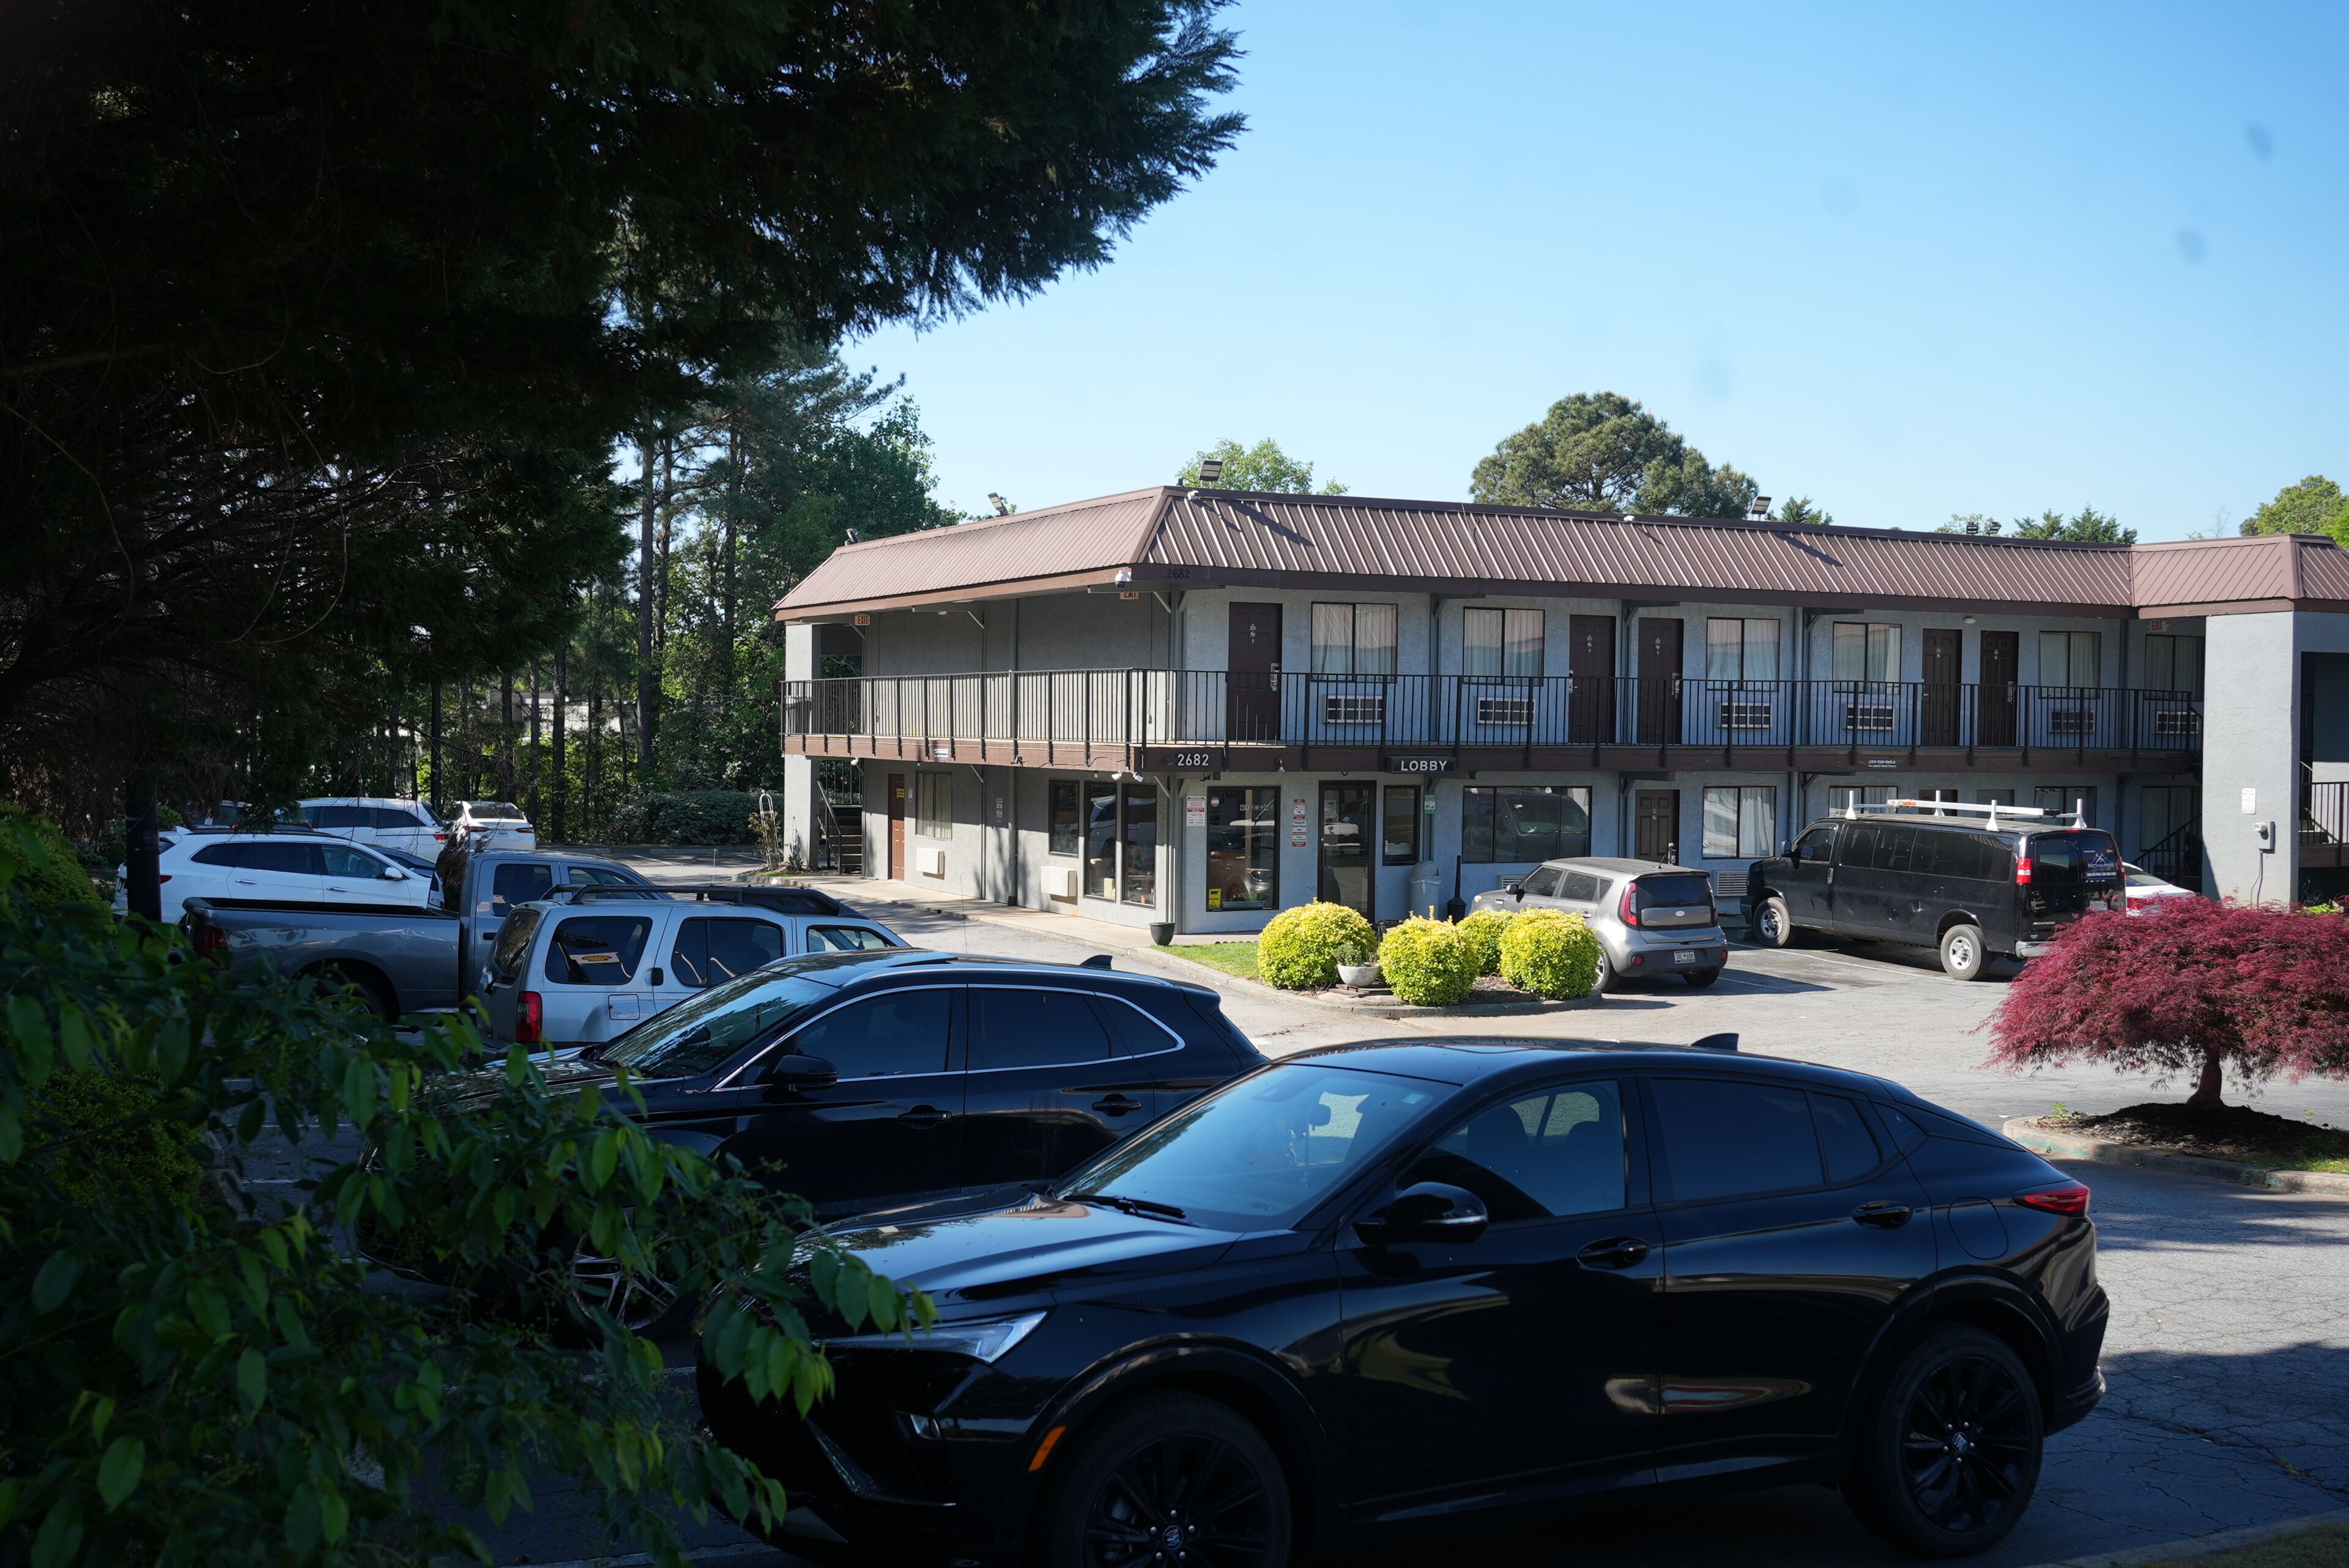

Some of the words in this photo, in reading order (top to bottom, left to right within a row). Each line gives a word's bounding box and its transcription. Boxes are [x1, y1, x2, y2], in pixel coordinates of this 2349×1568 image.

[1167, 568, 1190, 579] 2682
[858, 615, 868, 624] EXIT
[2152, 621, 2162, 631] EXIT
[1177, 753, 1209, 766] 2682
[1401, 760, 1447, 771] LOBBY
